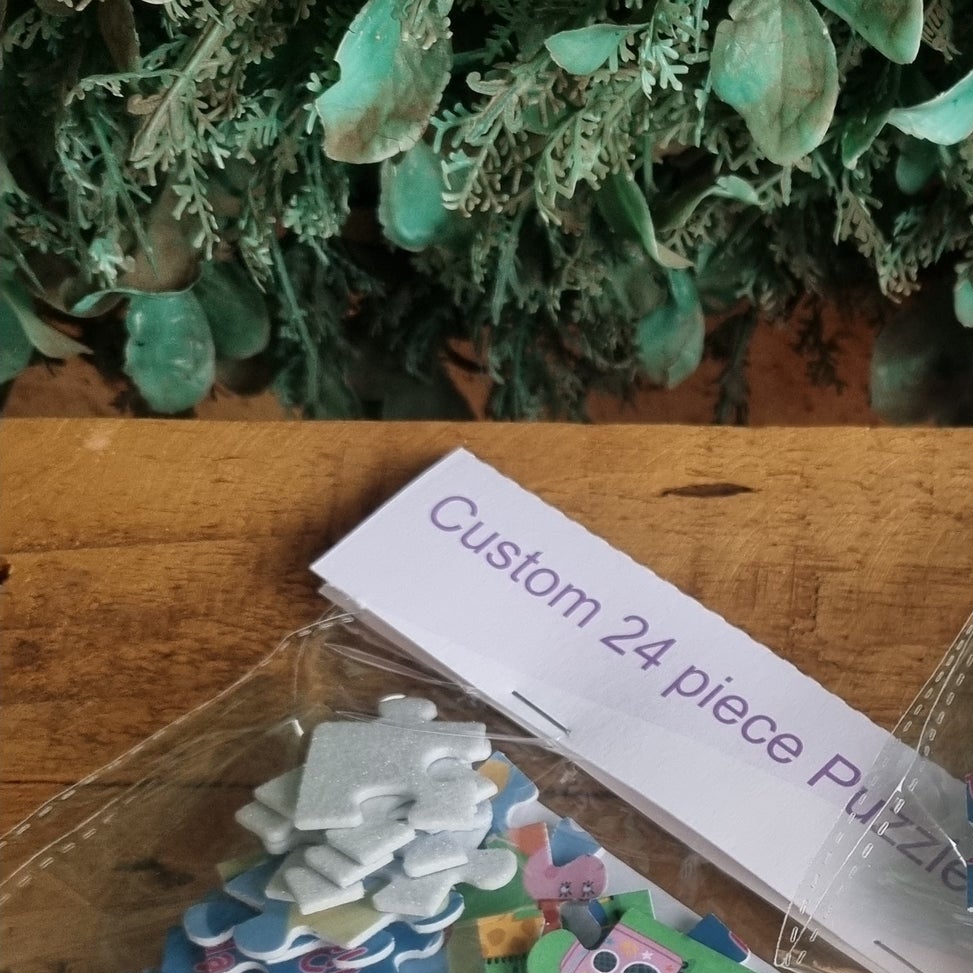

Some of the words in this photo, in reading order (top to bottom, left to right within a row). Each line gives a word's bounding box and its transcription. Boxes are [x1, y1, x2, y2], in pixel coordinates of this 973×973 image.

[430, 495, 602, 628] Custom
[599, 615, 677, 671] 24
[660, 665, 804, 764] piece
[807, 753, 967, 891] Puzzle
